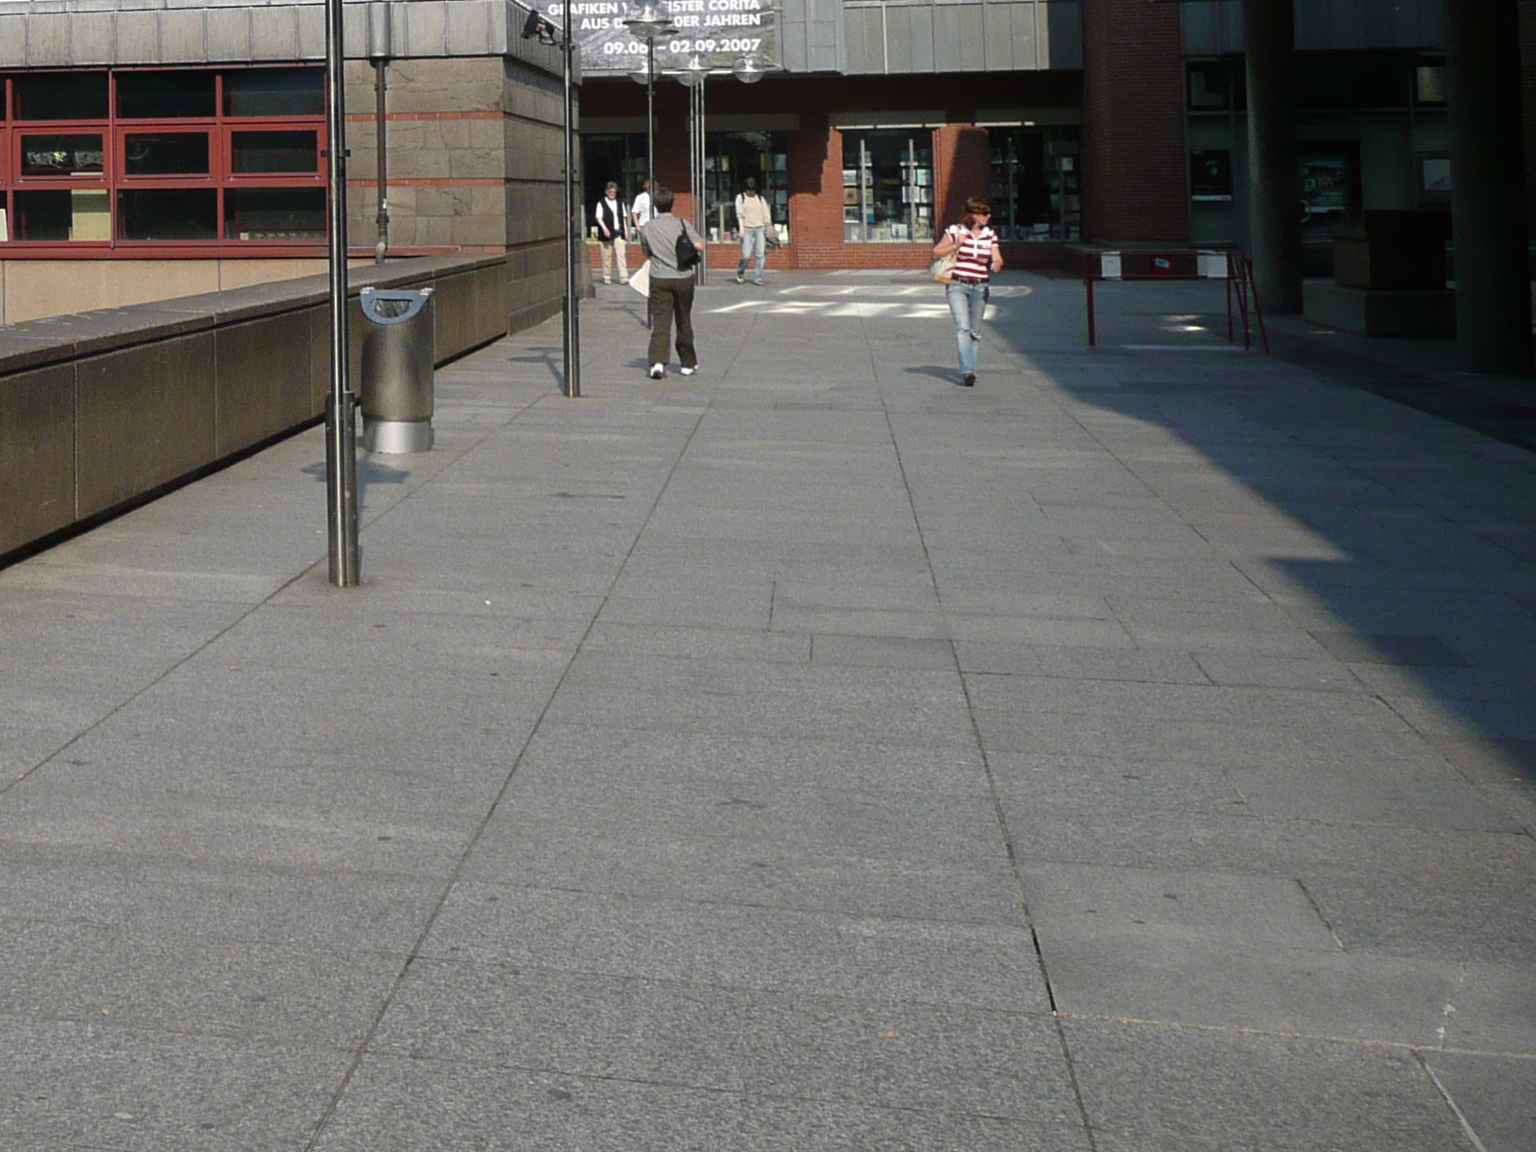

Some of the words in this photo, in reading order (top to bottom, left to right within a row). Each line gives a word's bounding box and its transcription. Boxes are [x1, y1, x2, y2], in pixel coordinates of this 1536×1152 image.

[664, 0, 705, 12] ISTER
[580, 17, 610, 30] AUS
[672, 15, 700, 27] 0ER
[704, 14, 761, 26] JAHREN
[670, 38, 761, 53] 02.09.2007
